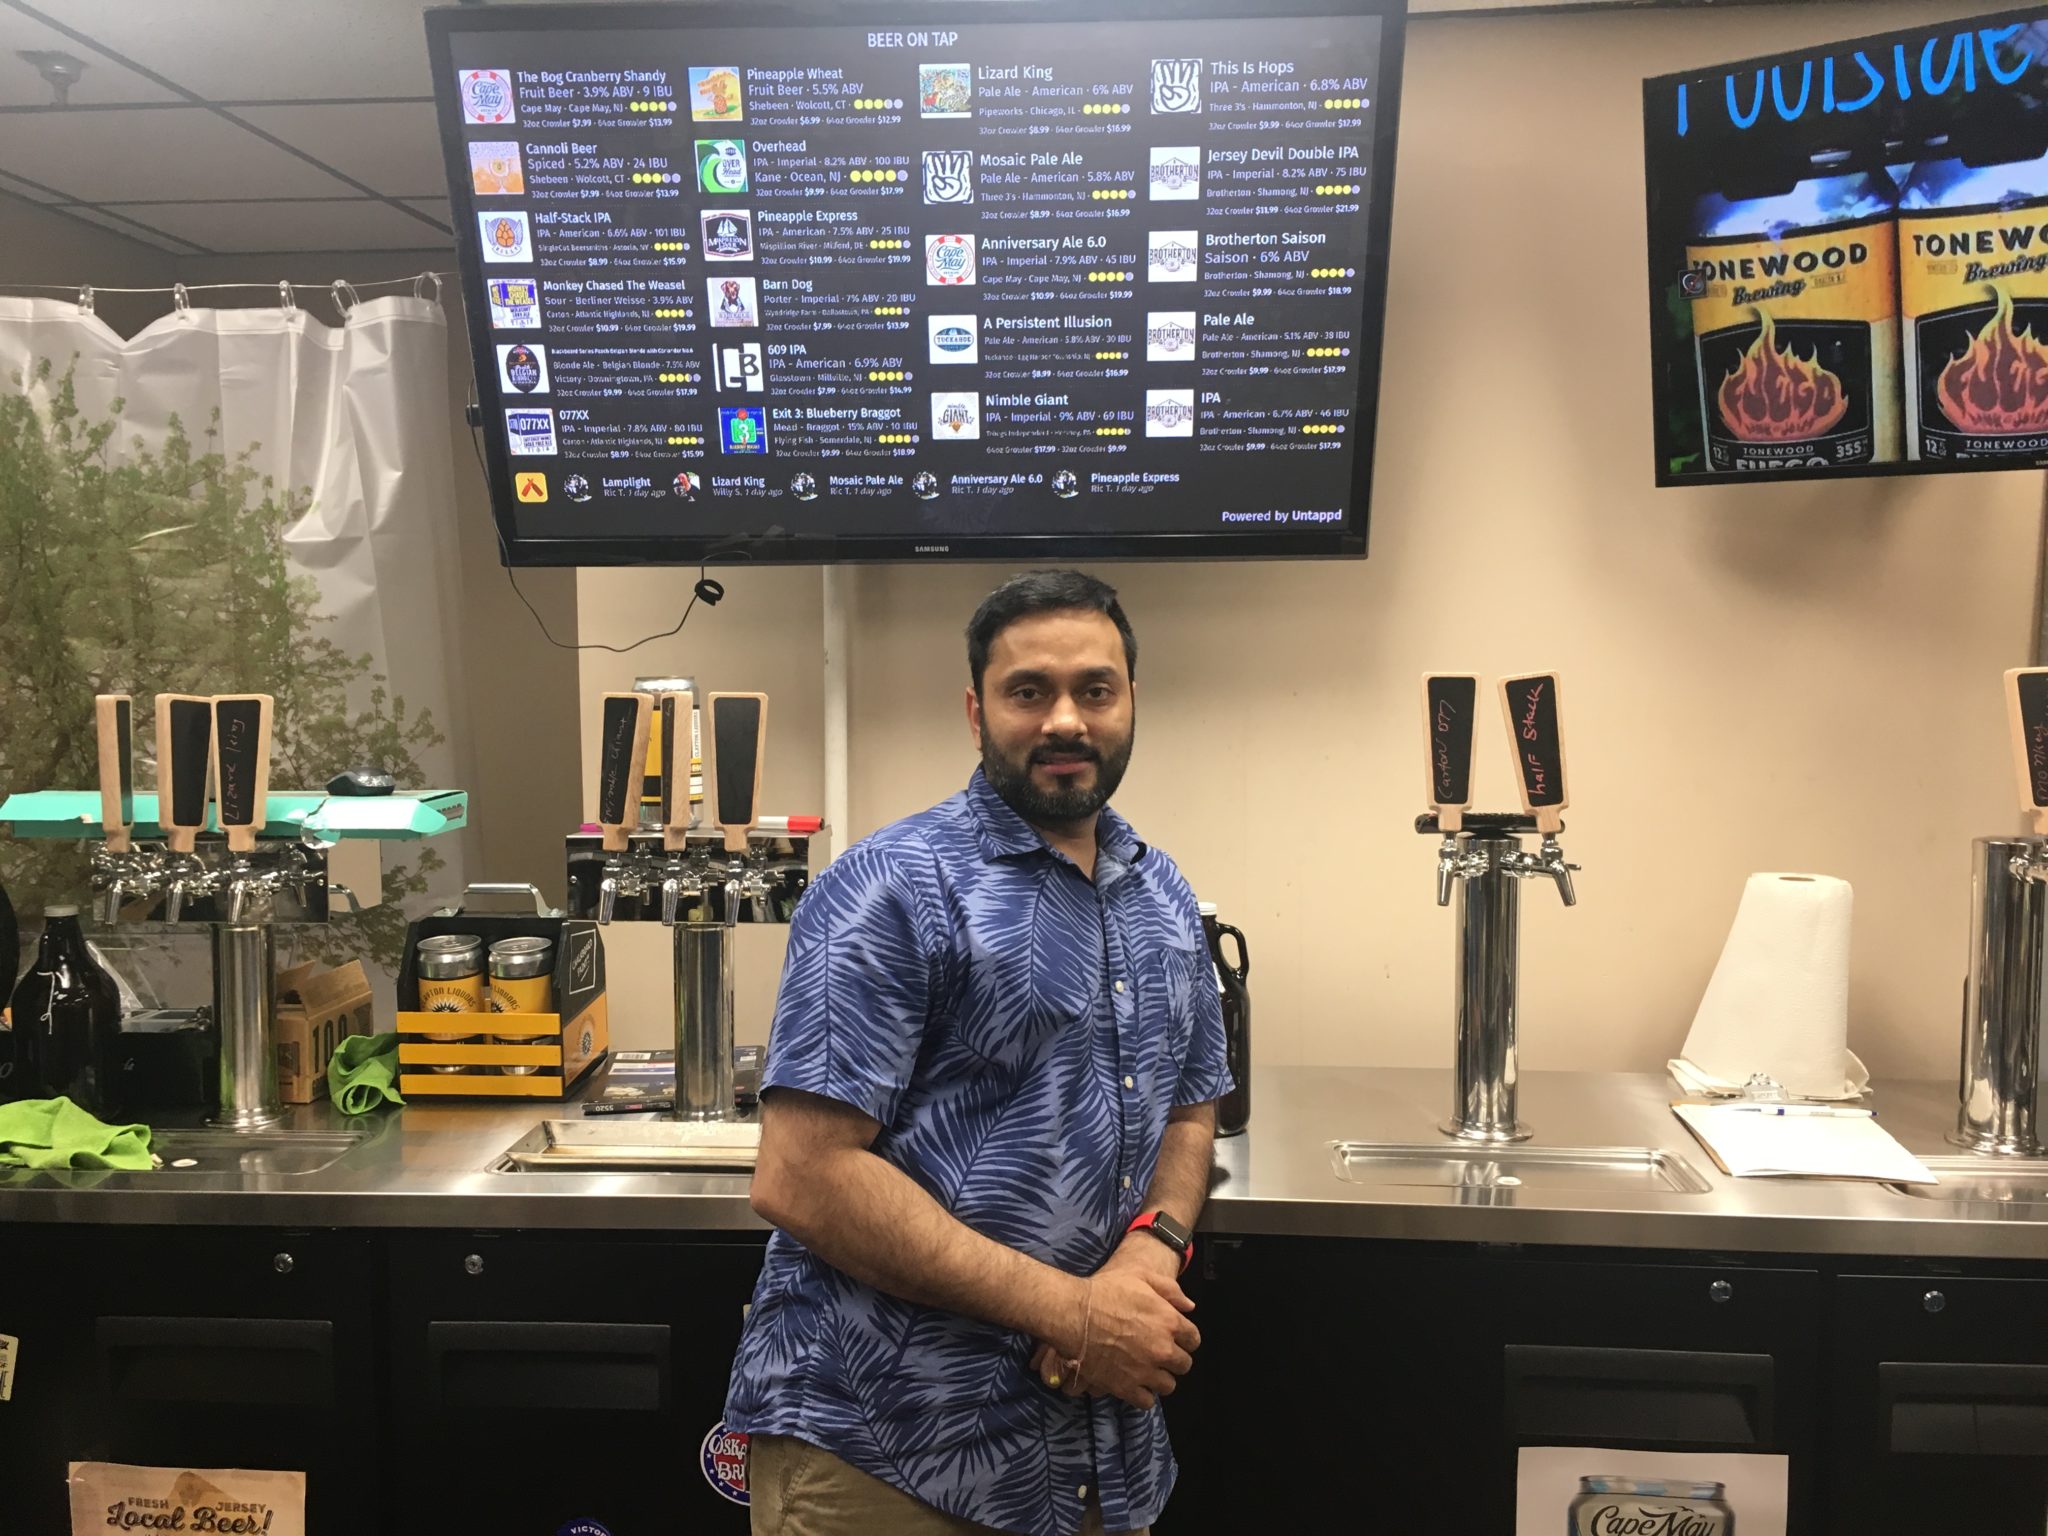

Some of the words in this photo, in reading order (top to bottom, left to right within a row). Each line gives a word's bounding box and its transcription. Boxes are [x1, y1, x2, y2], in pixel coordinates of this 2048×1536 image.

[868, 33, 903, 48] BEER
[907, 32, 928, 47] ON
[932, 32, 958, 46] TAP
[748, 68, 804, 82] Pineapple
[807, 68, 843, 79] Wheat
[978, 66, 1017, 79] Lizard
[1024, 65, 1053, 81] King
[1211, 62, 1238, 75] This
[1243, 62, 1254, 74] Is
[1259, 61, 1294, 76] Hops
[518, 72, 538, 83] The
[541, 72, 563, 85] Bog
[566, 71, 621, 84] Cranberry
[624, 70, 666, 84] Shandy
[749, 84, 774, 96] Fruit
[778, 85, 803, 95] Beer
[813, 84, 838, 94] 5.5%
[842, 84, 863, 94] ABV
[979, 87, 1000, 97] Pale
[1005, 86, 1021, 96] Ale
[1032, 85, 1083, 96] American
[1092, 85, 1108, 95] 6%
[1112, 84, 1133, 94] ABV
[1211, 82, 1229, 93] IPA
[1241, 81, 1299, 92] American
[1310, 79, 1340, 91] 6.8%
[1343, 78, 1367, 90] ABV
[520, 87, 545, 98] Fruit
[548, 88, 573, 98] Beer
[584, 87, 609, 97] 3.9%
[613, 87, 633, 97] ABV
[643, 87, 649, 97] 9
[653, 87, 672, 97] IBU
[521, 104, 542, 115] Cape
[545, 104, 561, 114] May
[569, 104, 590, 114] Cape
[614, 103, 623, 114] NJ
[526, 143, 568, 154] Cannoli
[572, 143, 597, 154] Beer
[753, 140, 806, 152] Overhead
[980, 153, 1025, 166] Mosaic
[1031, 154, 1058, 166] Pale
[1062, 153, 1083, 165] Ale
[1208, 149, 1247, 164] Jersey
[1252, 148, 1283, 160] Devil
[1288, 147, 1334, 159] Double
[1339, 147, 1359, 159] IPA
[528, 159, 564, 171] Spiced
[575, 158, 599, 169] 5.2%
[603, 158, 623, 168] ABV
[633, 158, 645, 168] 24
[649, 158, 667, 168] IBU
[755, 172, 781, 183] Kane
[790, 172, 826, 183] Ocean,
[830, 172, 840, 183] NJ
[535, 213, 591, 223] Half-Stack
[594, 213, 611, 223] IPA
[758, 211, 813, 224] Pineapple
[817, 211, 857, 223] Express
[982, 237, 1059, 251] Anniversary
[1063, 236, 1082, 248] Ale
[1087, 237, 1106, 247] 6.0
[1206, 234, 1277, 246] Brotherton
[1282, 232, 1326, 244] Saison
[1205, 253, 1248, 263] Saison
[1260, 252, 1279, 262] 6%
[1284, 251, 1309, 261] ABV
[1963, 253, 2048, 285] Brewing
[544, 281, 583, 293] Monkey
[586, 280, 623, 291] Chased
[626, 281, 645, 290] The
[648, 280, 685, 290] Weasel
[763, 280, 788, 290] Barn
[792, 280, 813, 292] Dog
[1732, 278, 1807, 306] Brewing
[984, 319, 992, 329] A
[996, 318, 1060, 328] Persistent
[1064, 316, 1112, 328] Illusion
[1204, 314, 1231, 326] Pale
[1234, 313, 1254, 325] Ale
[768, 345, 786, 355] 609
[789, 345, 806, 354] IPA
[770, 359, 785, 368] IPA
[796, 358, 845, 368] American
[854, 358, 879, 367] 6.9%
[882, 358, 902, 367] ABV
[986, 395, 1032, 406] Nimble
[1035, 395, 1068, 406] Giant
[1202, 393, 1221, 403] IPA
[560, 410, 589, 420] 077XX
[773, 409, 792, 419] Exit
[794, 409, 804, 419] 3:
[807, 408, 858, 420] Blueberry
[861, 408, 901, 420] Braggot
[986, 413, 1001, 422] IPA
[1011, 412, 1050, 422] Imperial
[1059, 412, 1073, 421] 9%
[1077, 412, 1095, 421] ABV
[1103, 412, 1114, 421] 69
[1118, 412, 1134, 420] IBU
[520, 418, 549, 431] 077XX
[1836, 440, 1862, 458] 355
[1966, 438, 2048, 449] TONEWOOD
[1743, 445, 1814, 456] TONEWOOD
[603, 478, 651, 489] Lamplight
[712, 477, 741, 486] Lizard
[744, 477, 765, 487] King
[830, 476, 863, 485] Mosaic
[866, 476, 885, 485] Pale
[888, 476, 903, 485] Ale
[952, 475, 1008, 485] Anniversary
[1011, 474, 1026, 484] Ale
[1028, 474, 1043, 483] 6.0
[1091, 473, 1139, 484] Pineapple
[1143, 473, 1179, 483] Express
[983, 486, 997, 494] day
[1222, 511, 1270, 522] Powered
[1275, 511, 1288, 522] by
[1292, 509, 1342, 523] Untappd
[447, 987, 476, 1008] LIQUORS
[708, 1434, 748, 1461] OSKA
[128, 1497, 169, 1509] FRESH
[215, 1501, 266, 1514] JERSEY
[107, 1501, 185, 1531] Local
[190, 1505, 274, 1536] Beer!
[1591, 1505, 1655, 1536] Cape
[1638, 1507, 1716, 1536] May
